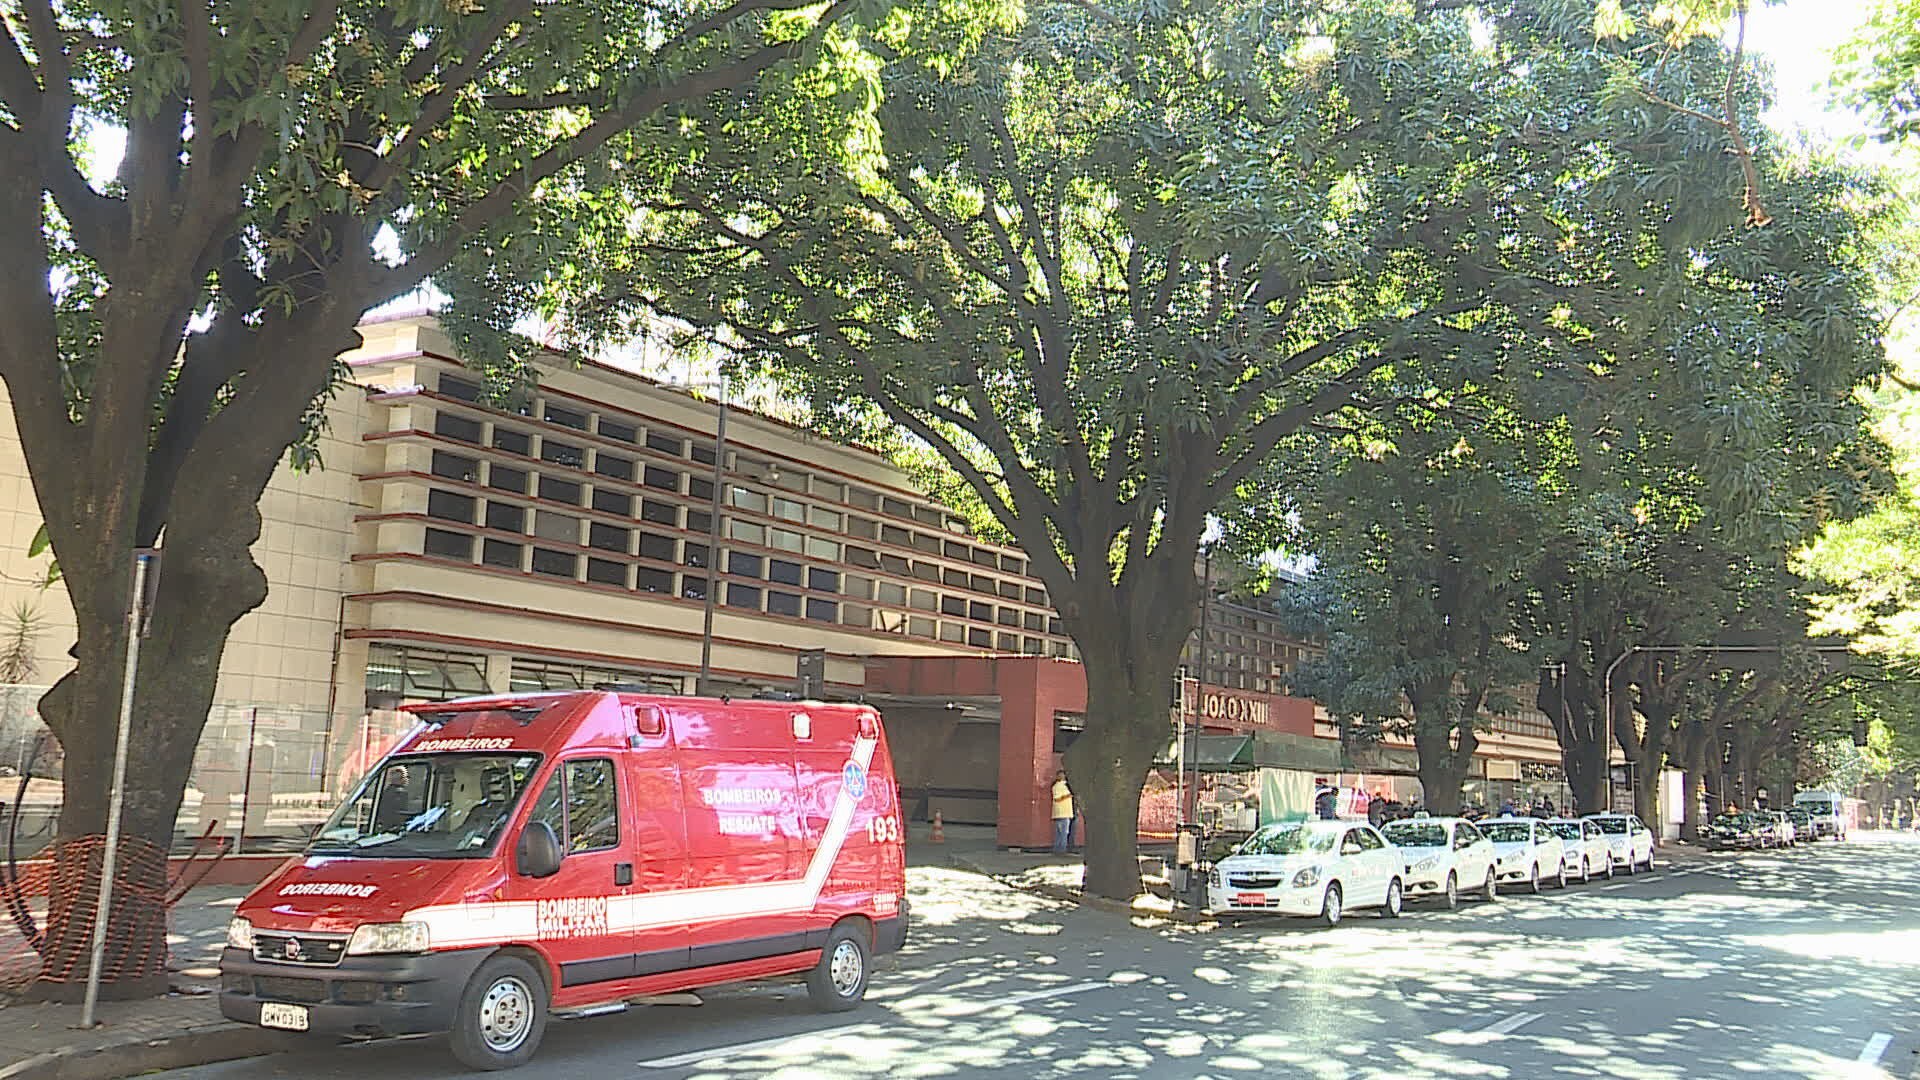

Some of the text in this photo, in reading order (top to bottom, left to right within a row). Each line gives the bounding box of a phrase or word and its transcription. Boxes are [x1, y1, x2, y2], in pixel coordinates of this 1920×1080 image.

[1201, 691, 1238, 720] JOÃO
[1239, 699, 1268, 724] XXIII
[414, 737, 513, 751] BOMBEIROS
[703, 787, 781, 805] BOMBEIROS
[866, 816, 897, 843] 193
[537, 896, 606, 918] BOMBEIRO
[538, 915, 606, 931] MILITAR
